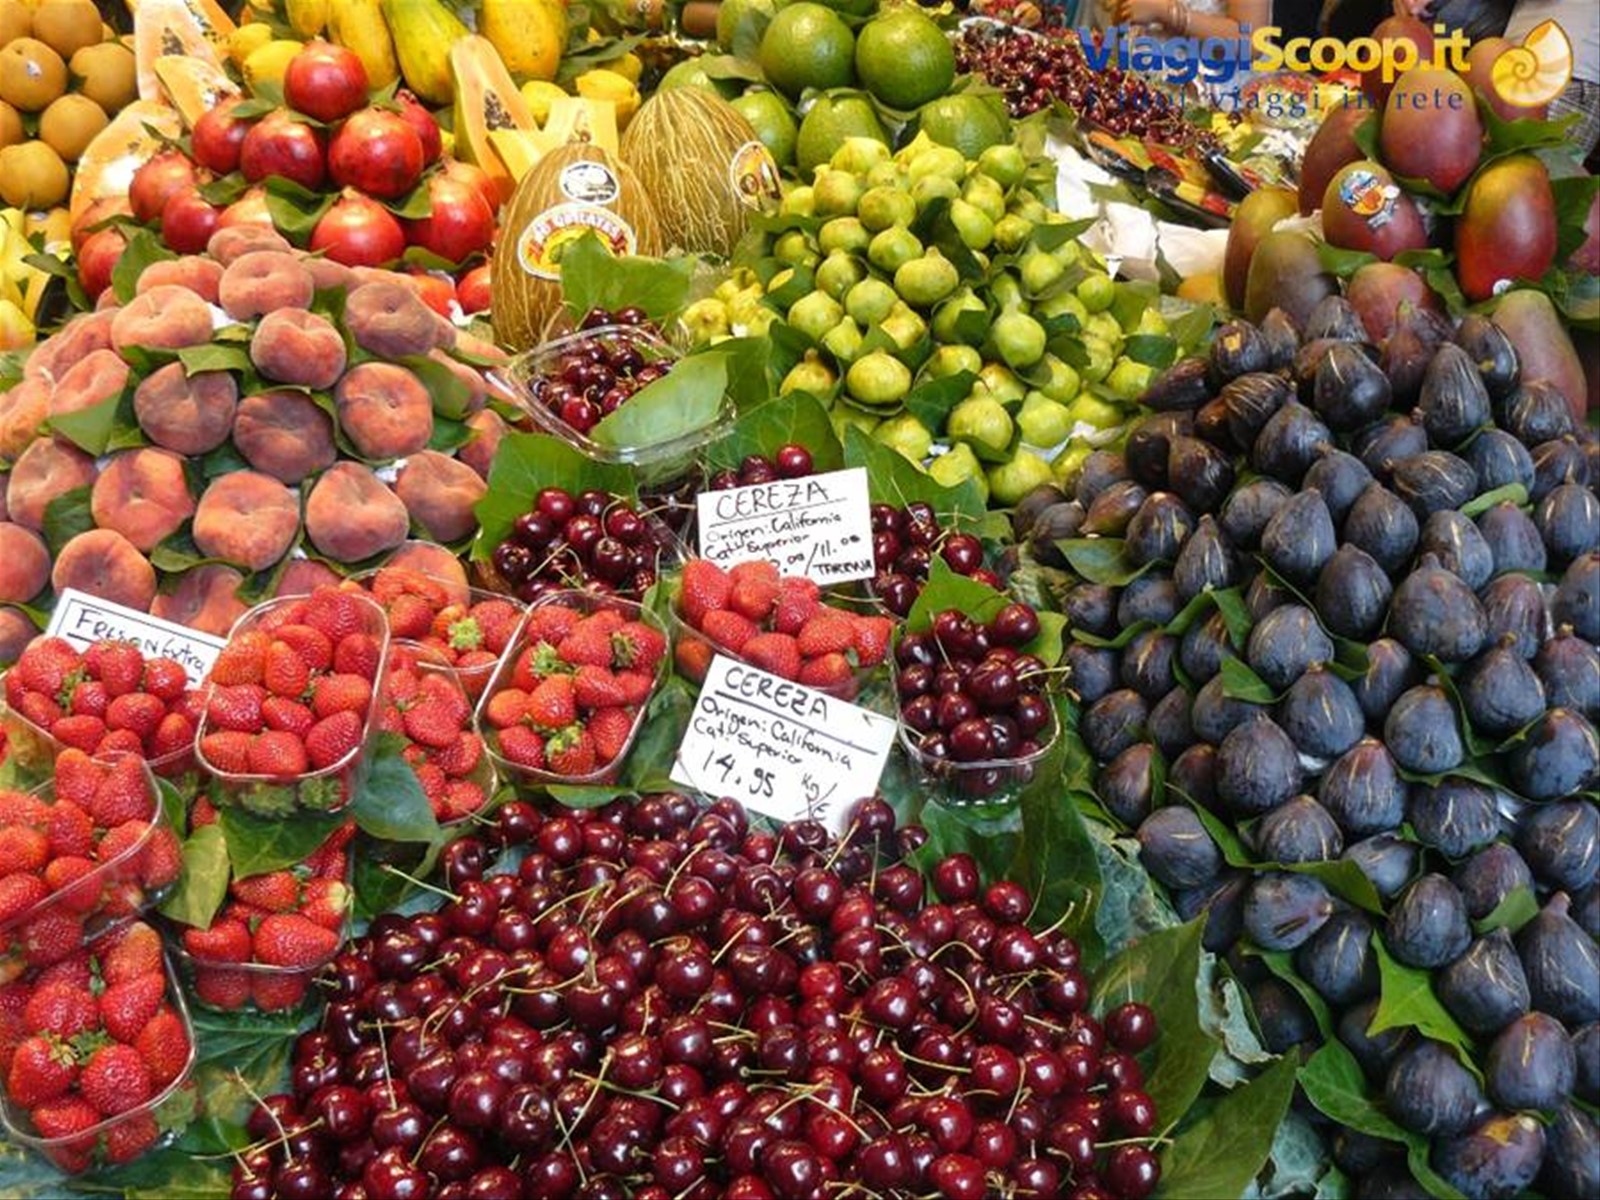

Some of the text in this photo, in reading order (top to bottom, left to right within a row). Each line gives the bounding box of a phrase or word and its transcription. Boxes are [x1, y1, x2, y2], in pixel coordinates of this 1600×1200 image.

[716, 480, 829, 521] CEREZA
[771, 510, 842, 534] California
[724, 666, 828, 721] CEREZA
[770, 720, 852, 771] California
[703, 750, 776, 797] 14.95
